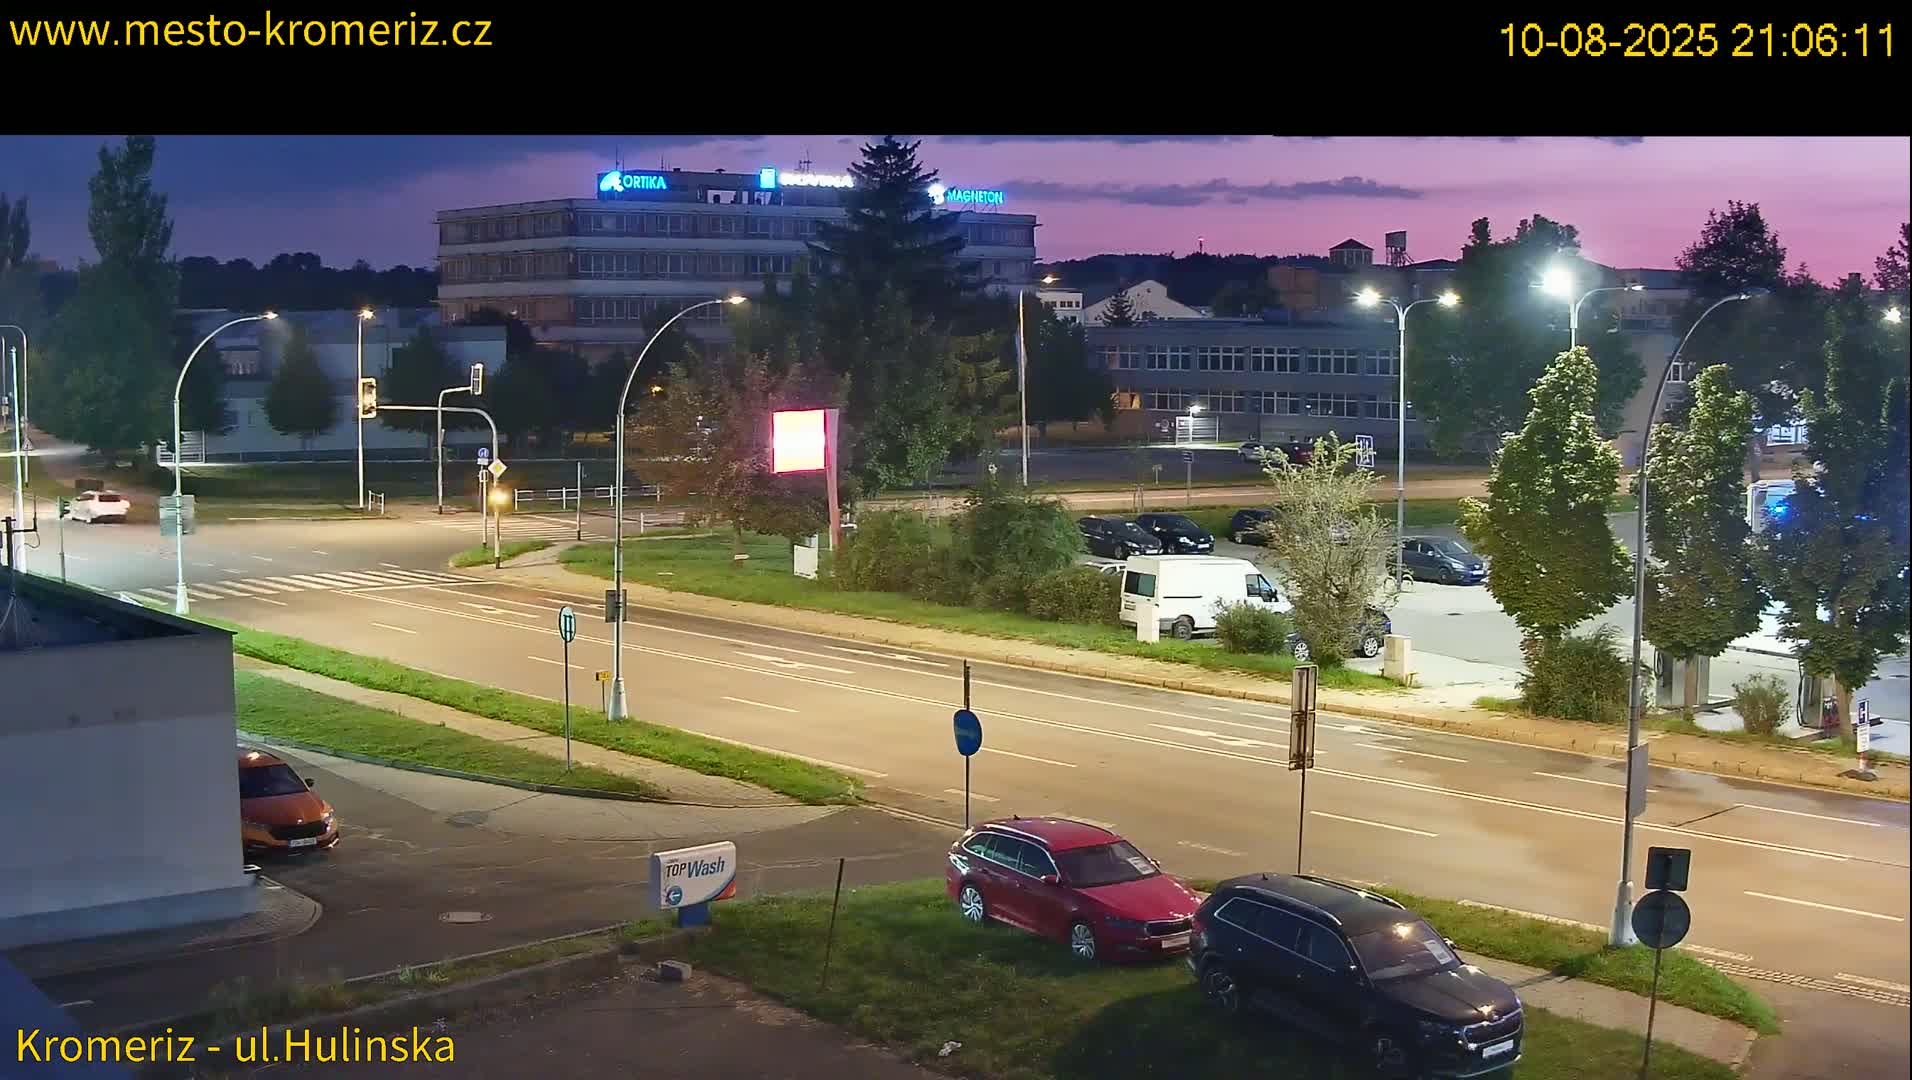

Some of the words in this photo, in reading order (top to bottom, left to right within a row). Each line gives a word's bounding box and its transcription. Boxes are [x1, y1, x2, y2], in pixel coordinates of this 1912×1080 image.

[622, 174, 668, 190] ORTIKA
[946, 188, 1004, 205] MAGNETON
[665, 862, 687, 878] TOP
[687, 856, 725, 879] Wash
